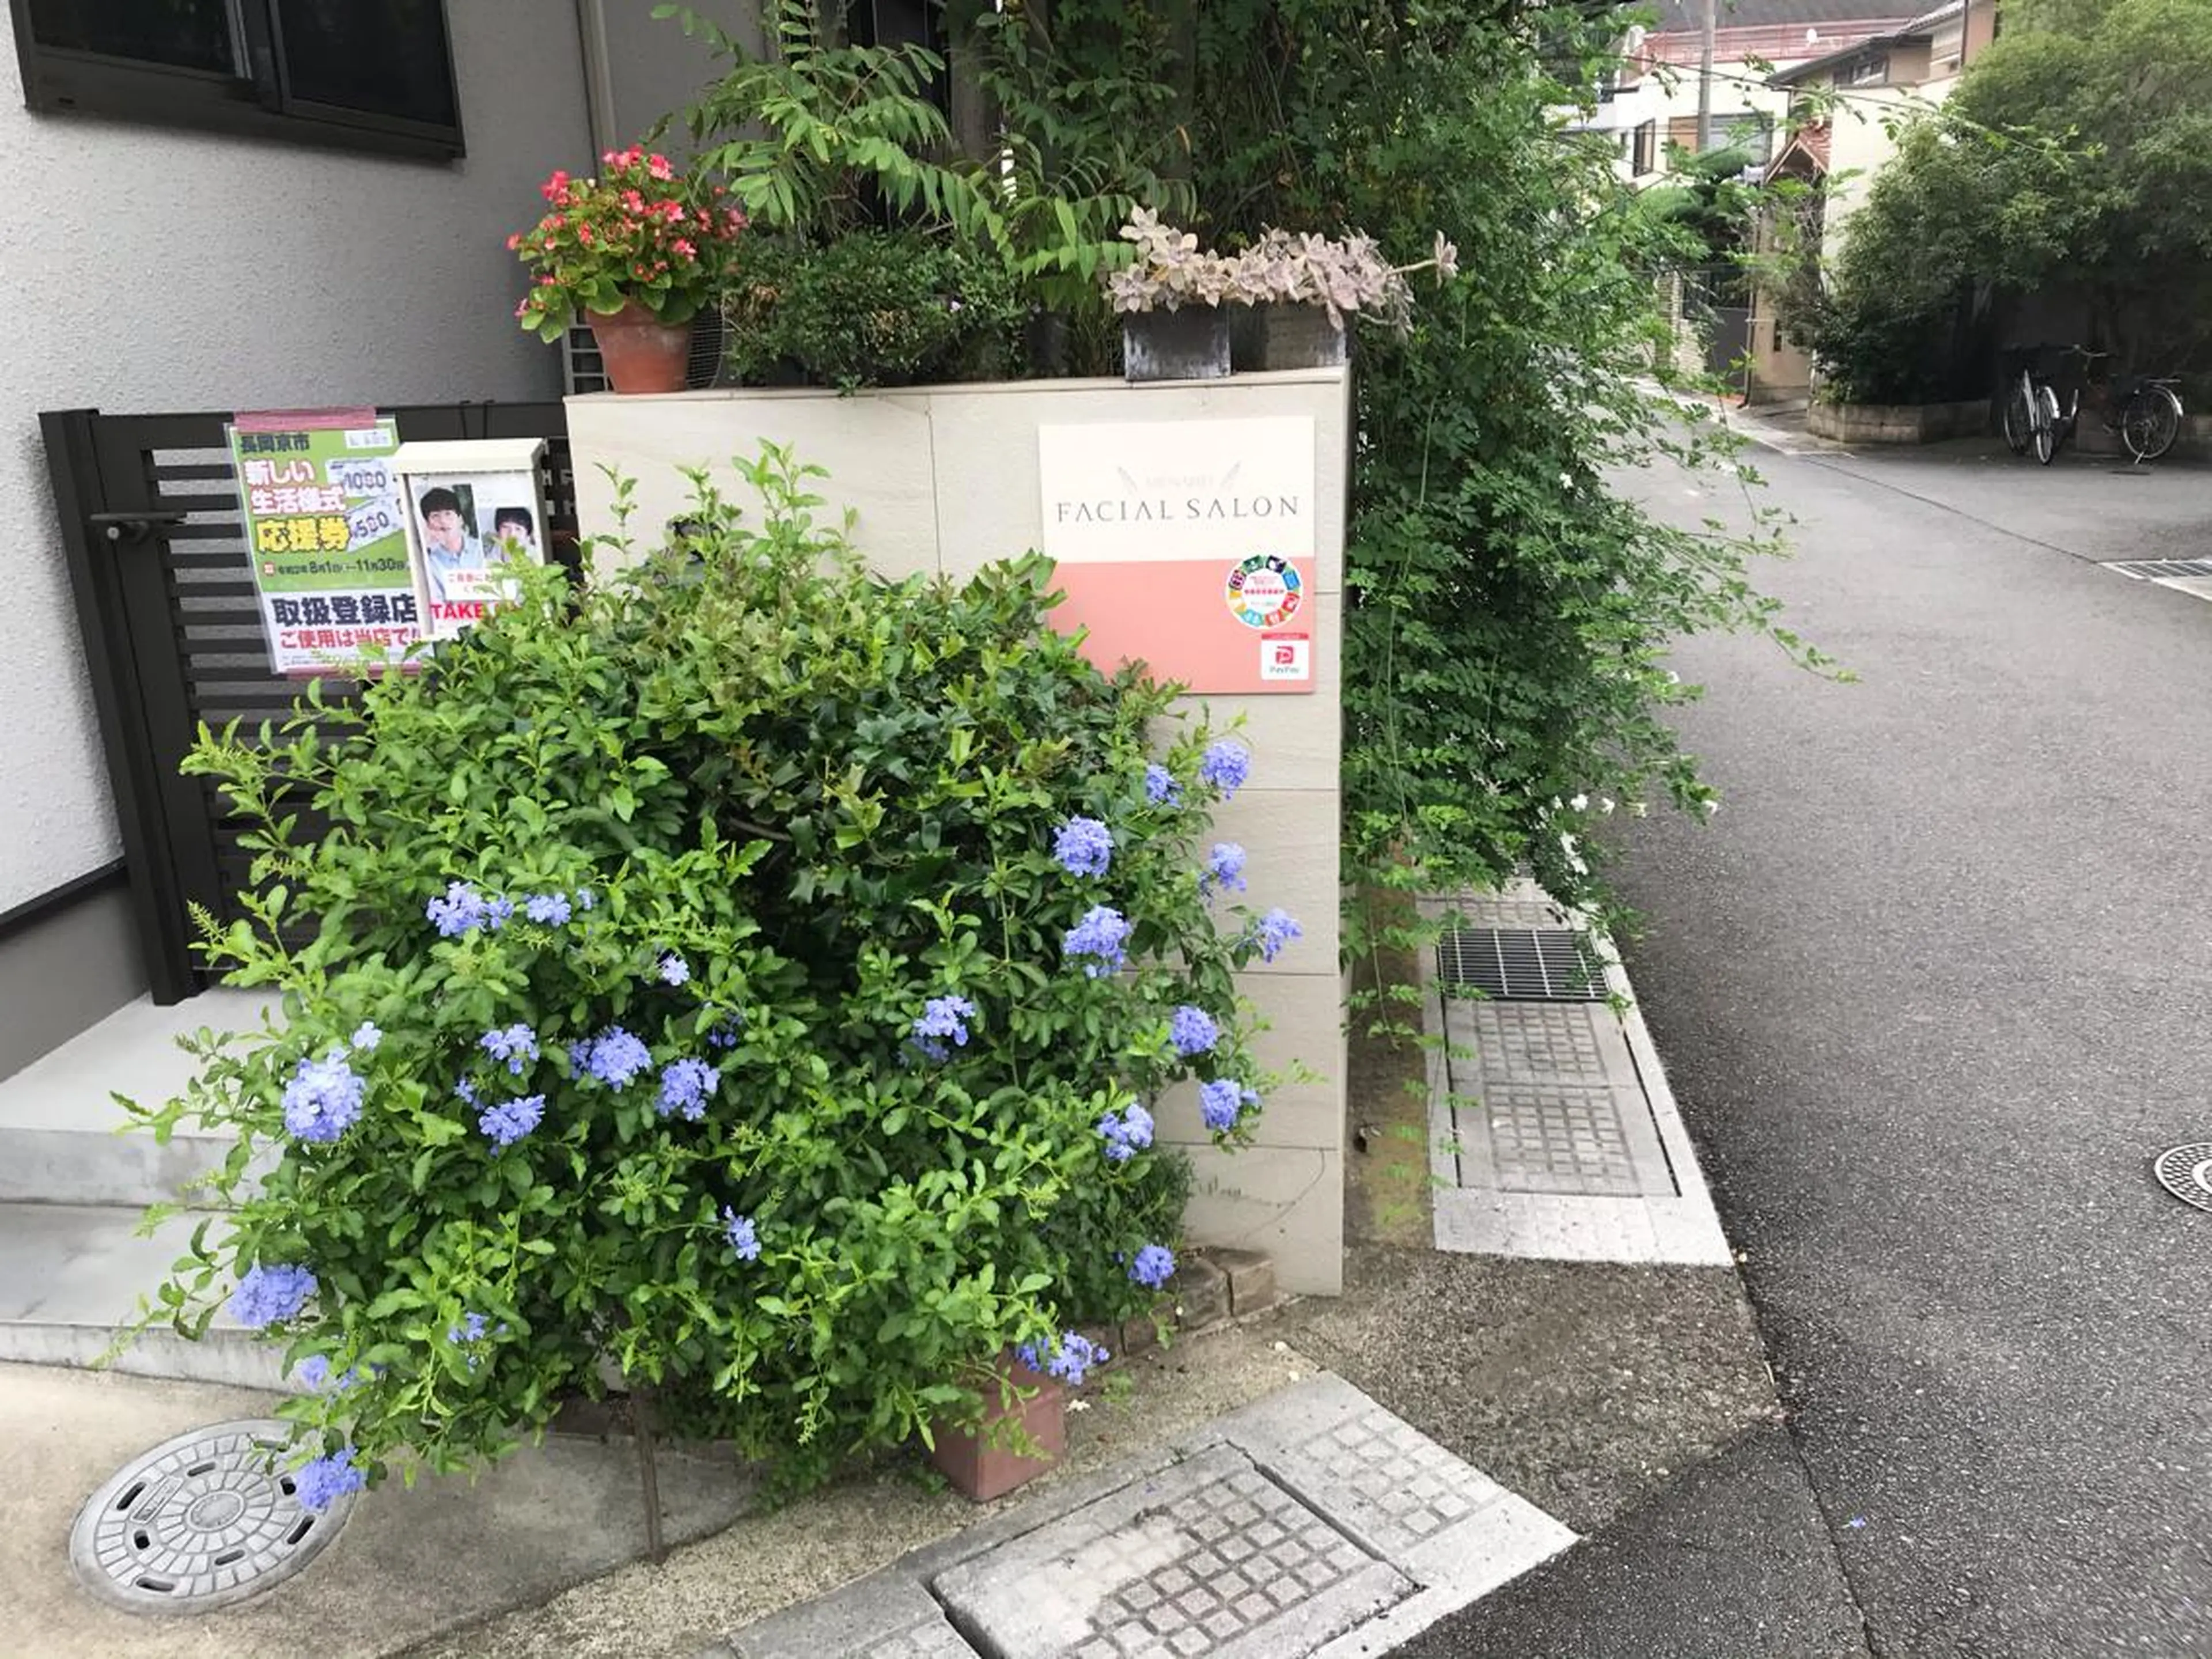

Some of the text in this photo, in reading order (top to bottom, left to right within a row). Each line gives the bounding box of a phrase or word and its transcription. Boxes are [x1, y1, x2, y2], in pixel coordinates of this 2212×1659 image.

[240, 433, 310, 453] 長岡京市
[243, 459, 315, 486] 新しい
[251, 486, 346, 514] 生活様式
[1056, 495, 1299, 522] FACIAL SALON
[256, 516, 350, 552] 応援券
[271, 594, 418, 627] 取扱登録店
[430, 600, 484, 620] TAKE
